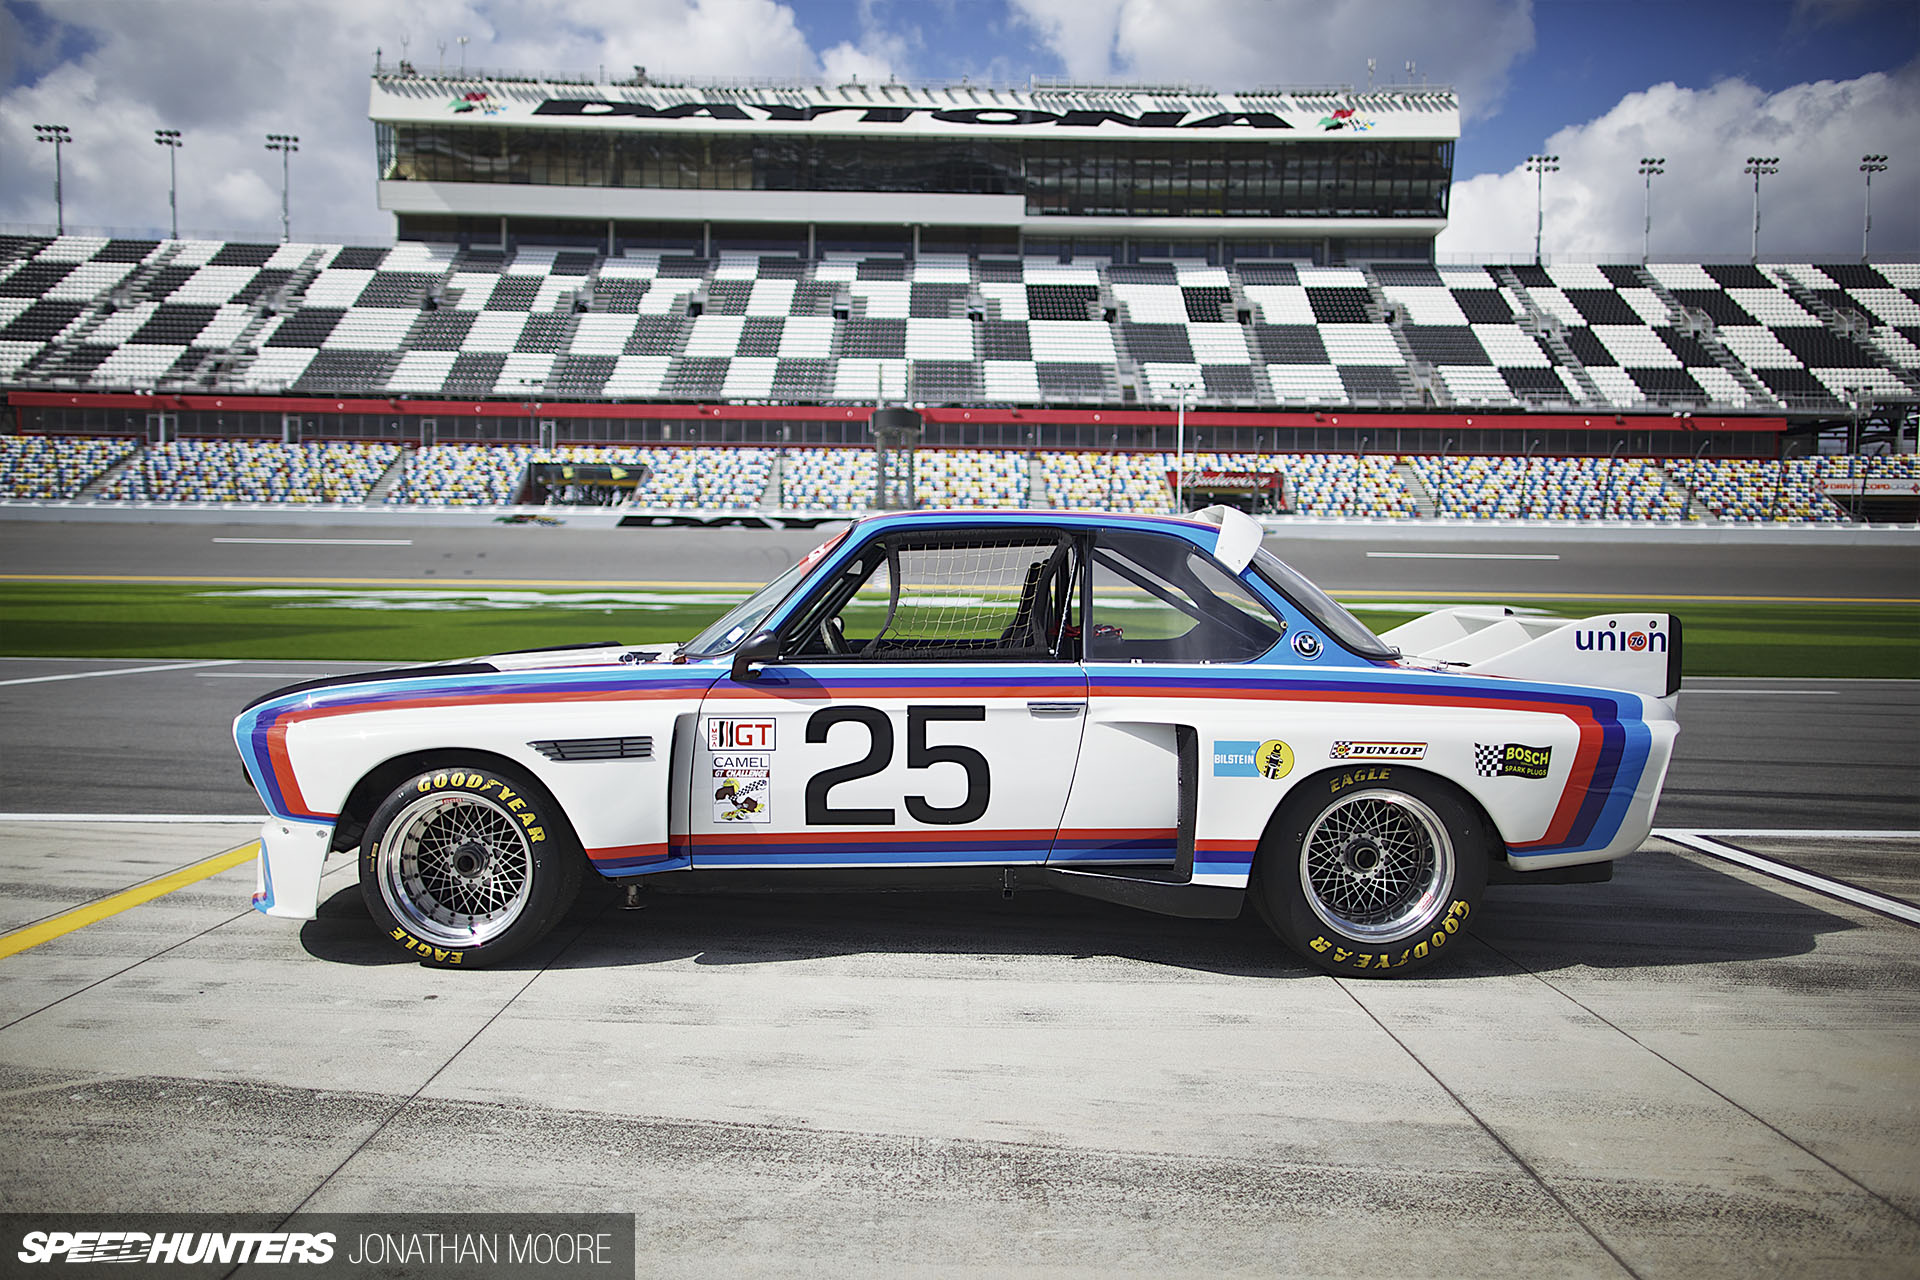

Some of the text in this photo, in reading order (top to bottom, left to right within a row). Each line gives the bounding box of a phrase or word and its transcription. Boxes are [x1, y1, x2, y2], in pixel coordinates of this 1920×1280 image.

[531, 99, 1295, 128] DAYTONA
[1181, 471, 1272, 488] Budweiser
[1629, 635, 1645, 647] 76
[735, 724, 772, 746] GT
[1352, 745, 1423, 755] DUNLOP
[1506, 747, 1549, 765] BOSCH
[713, 757, 768, 768] CAMEL
[804, 704, 992, 826] 25
[1214, 754, 1255, 765] BILSTEIN
[725, 769, 768, 777] CHALLENGE
[1504, 765, 1547, 776] SPARK PLUGS
[1329, 767, 1392, 793] EAGLE
[417, 771, 548, 844] GOODYEAR
[1308, 899, 1472, 970] GOODYEAR
[388, 925, 465, 965] EAGLE
